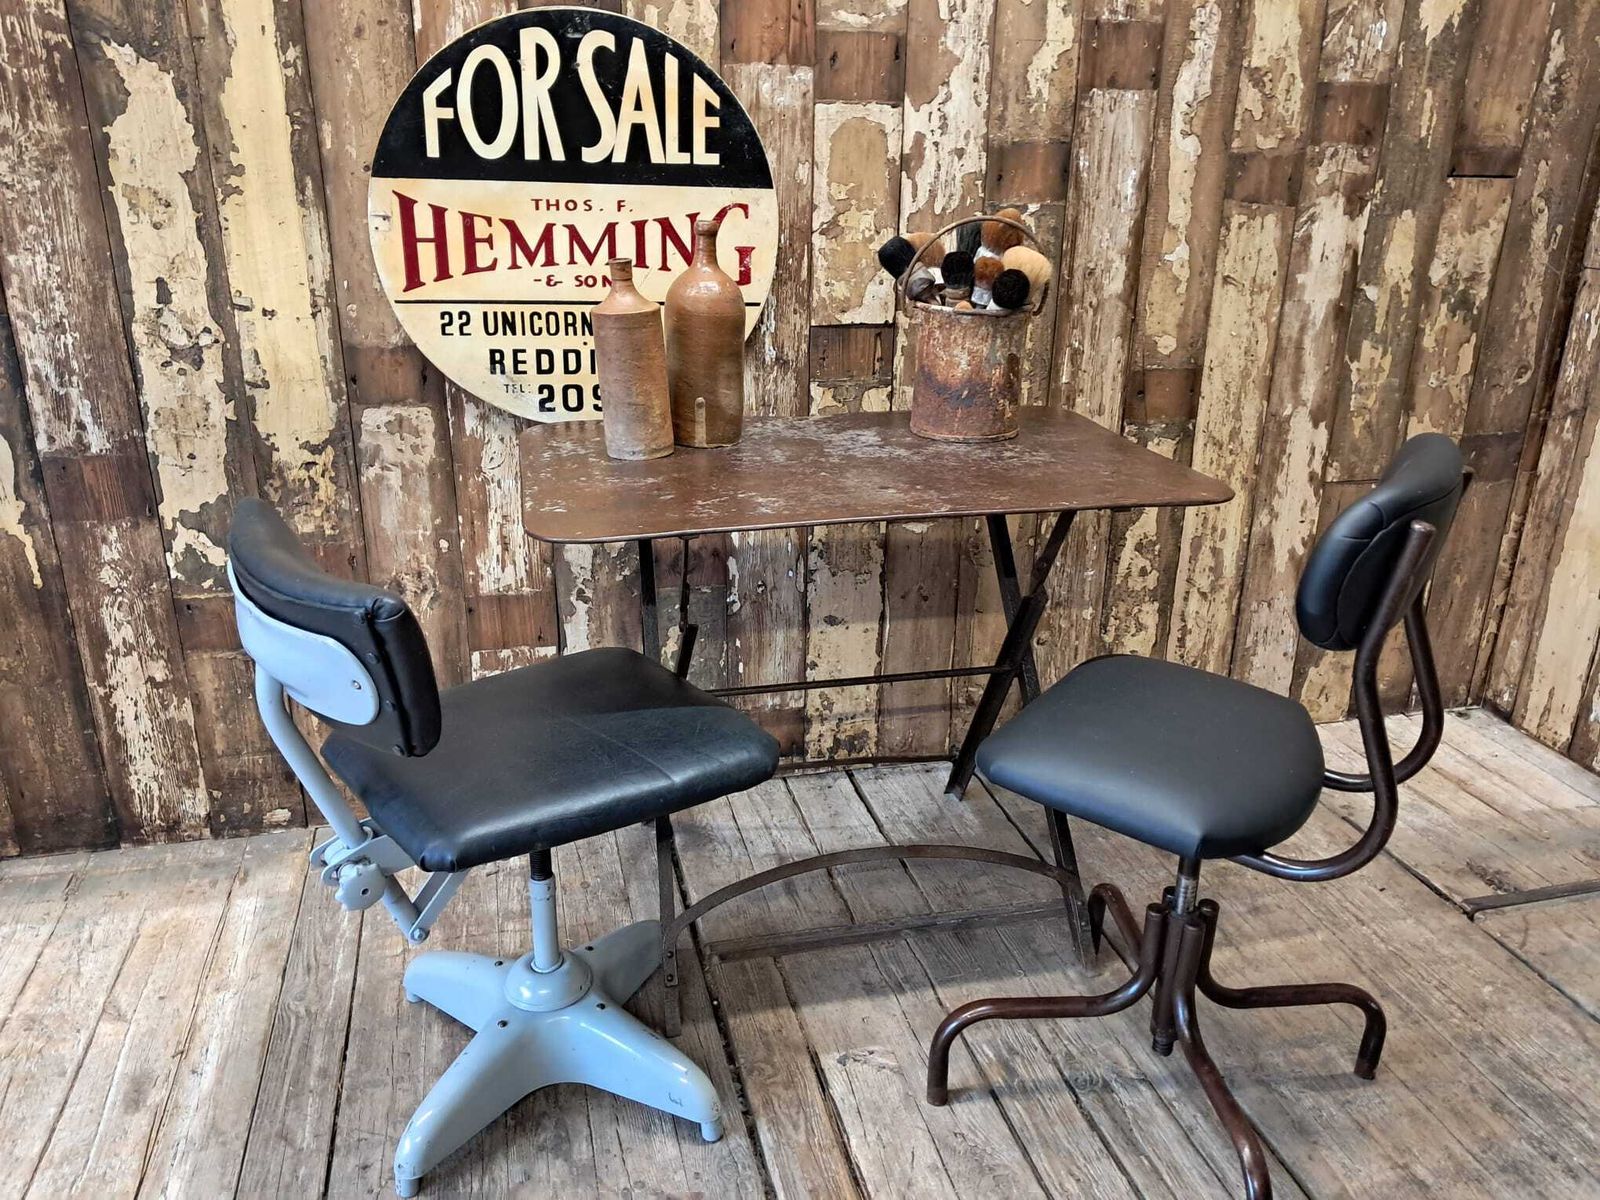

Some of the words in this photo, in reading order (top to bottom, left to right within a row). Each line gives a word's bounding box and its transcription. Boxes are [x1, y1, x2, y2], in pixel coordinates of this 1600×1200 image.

[423, 26, 565, 160] FOR
[576, 29, 721, 166] SALE
[531, 198, 604, 212] THOS.
[616, 199, 633, 213] F.
[392, 190, 756, 293] HEMMING
[440, 311, 472, 336] 22
[482, 310, 594, 337] UNICORN
[488, 348, 597, 375] REDDI
